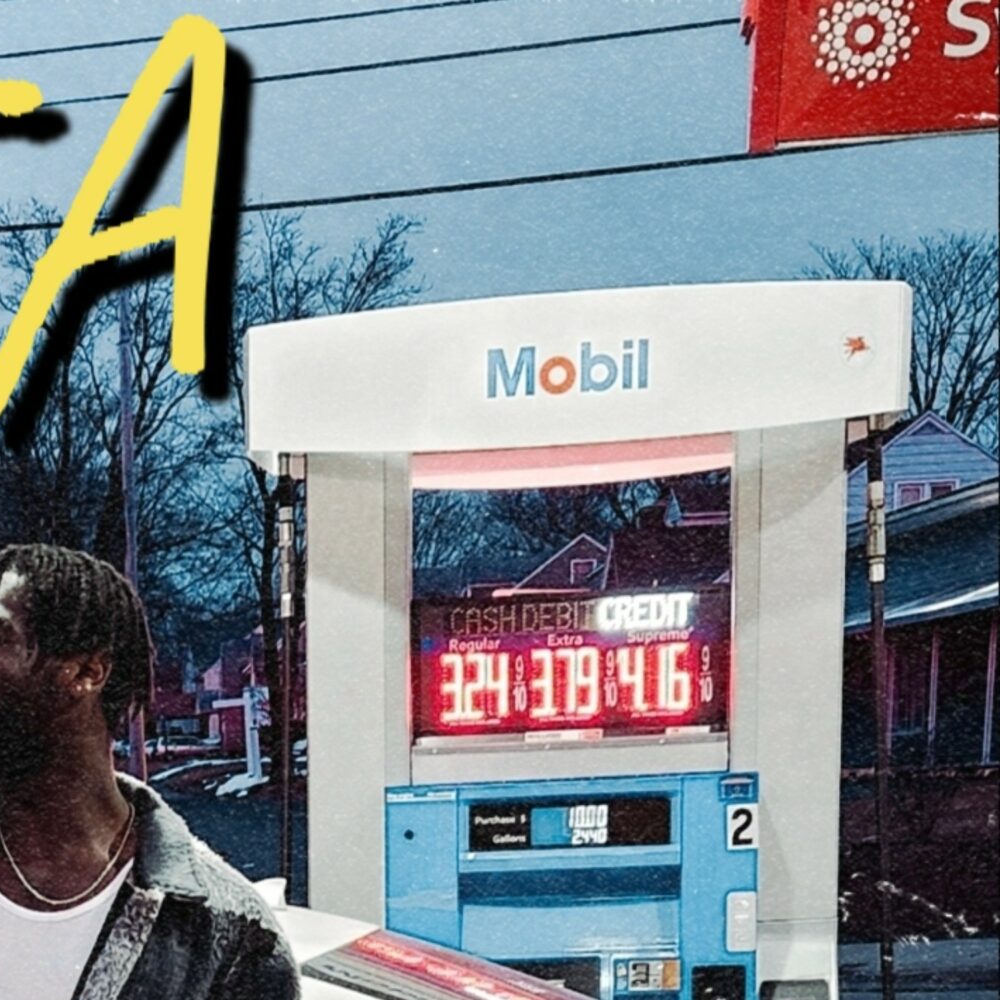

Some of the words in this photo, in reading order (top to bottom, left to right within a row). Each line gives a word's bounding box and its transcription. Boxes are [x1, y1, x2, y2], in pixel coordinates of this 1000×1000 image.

[487, 338, 651, 399] Mobil
[450, 604, 516, 636] CASH
[521, 599, 595, 632] DEBIT
[597, 592, 694, 631] CREDIT
[449, 637, 500, 653] Regular
[547, 634, 584, 646] Extra
[732, 807, 753, 846] 2
